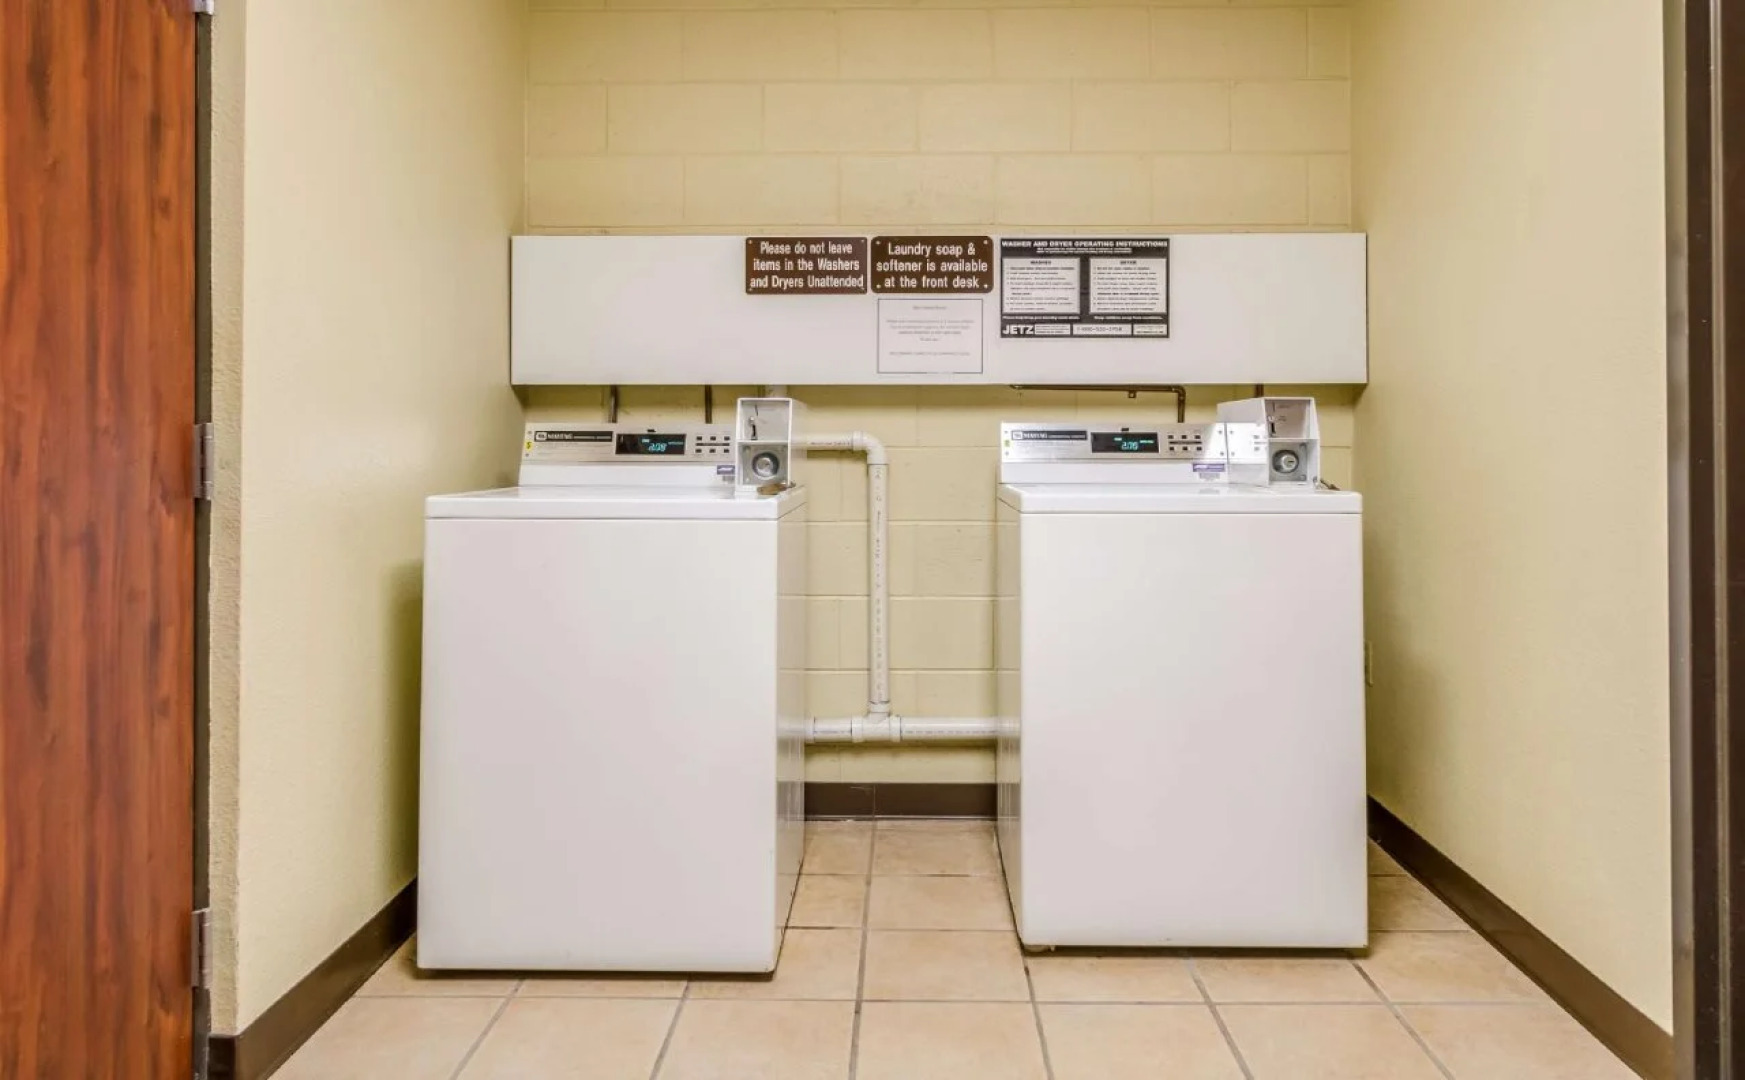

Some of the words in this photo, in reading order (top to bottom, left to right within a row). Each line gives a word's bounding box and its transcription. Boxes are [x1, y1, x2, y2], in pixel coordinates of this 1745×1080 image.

[760, 241, 791, 254] Please
[794, 241, 807, 254] do
[809, 241, 825, 254] not
[828, 241, 853, 254] leave
[888, 242, 931, 259] Laundry
[935, 245, 963, 258] soap
[967, 242, 976, 256] &
[753, 258, 781, 271] items
[784, 258, 794, 271] in
[798, 258, 813, 271] the
[817, 258, 860, 271] Washers
[876, 259, 922, 272] softener
[926, 259, 936, 272] is
[940, 259, 988, 272] available
[750, 275, 768, 288] and
[772, 275, 804, 291] Dryers
[807, 275, 864, 288] Unattended
[884, 276, 897, 288] at
[900, 276, 917, 288] the
[921, 276, 949, 288] front
[952, 276, 980, 288] desk
[1002, 325, 1034, 335] JETZ
